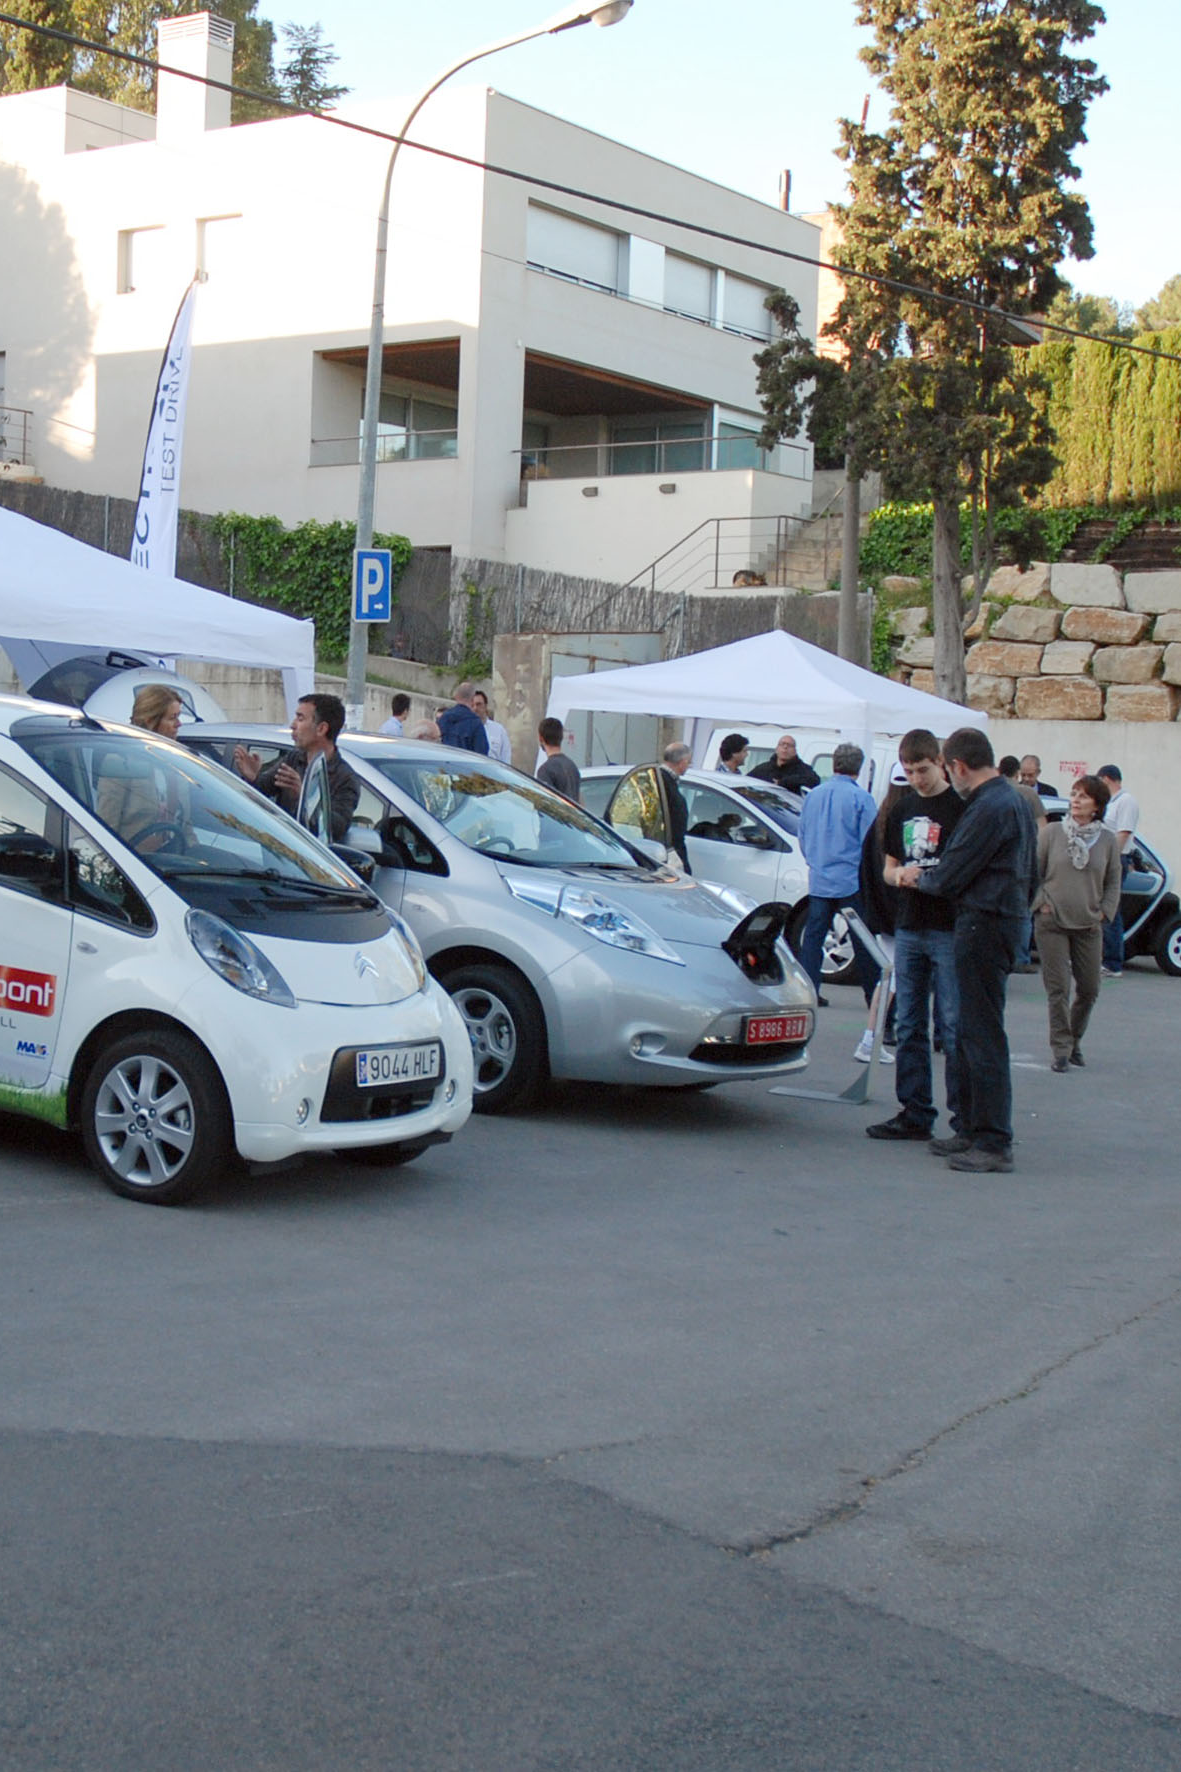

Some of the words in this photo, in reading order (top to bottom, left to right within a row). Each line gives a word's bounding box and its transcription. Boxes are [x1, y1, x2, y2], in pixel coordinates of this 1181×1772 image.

[160, 432, 176, 495] TEST
[362, 558, 384, 613] P
[370, 1053, 409, 1080] 9044
[413, 1049, 437, 1077] HLF
